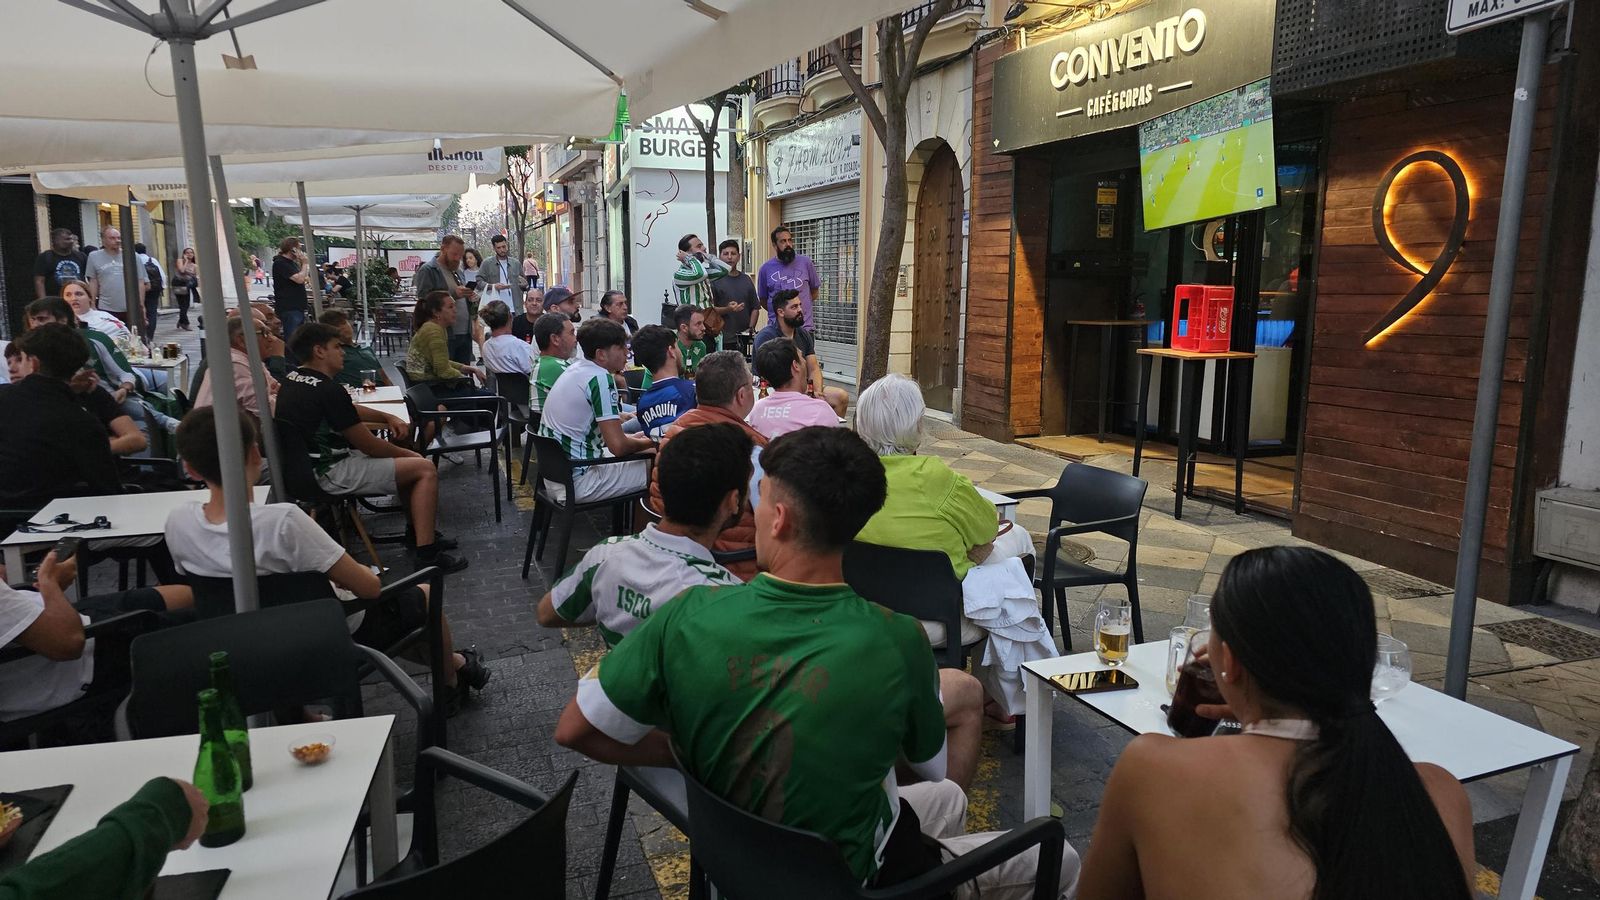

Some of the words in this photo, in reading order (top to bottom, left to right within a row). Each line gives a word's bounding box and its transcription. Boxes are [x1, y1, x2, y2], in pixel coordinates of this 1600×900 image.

[1050, 8, 1206, 89] CONVENTO
[1087, 83, 1153, 118] CAFÉ&COPAS
[641, 116, 719, 137] SMA
[639, 137, 721, 159] BURGER
[785, 135, 852, 184] FARMACIA
[428, 164, 458, 172] DESDE
[641, 400, 678, 428] JOAQUÍN
[760, 403, 792, 418] JESÉ
[617, 584, 651, 620] ISCO
